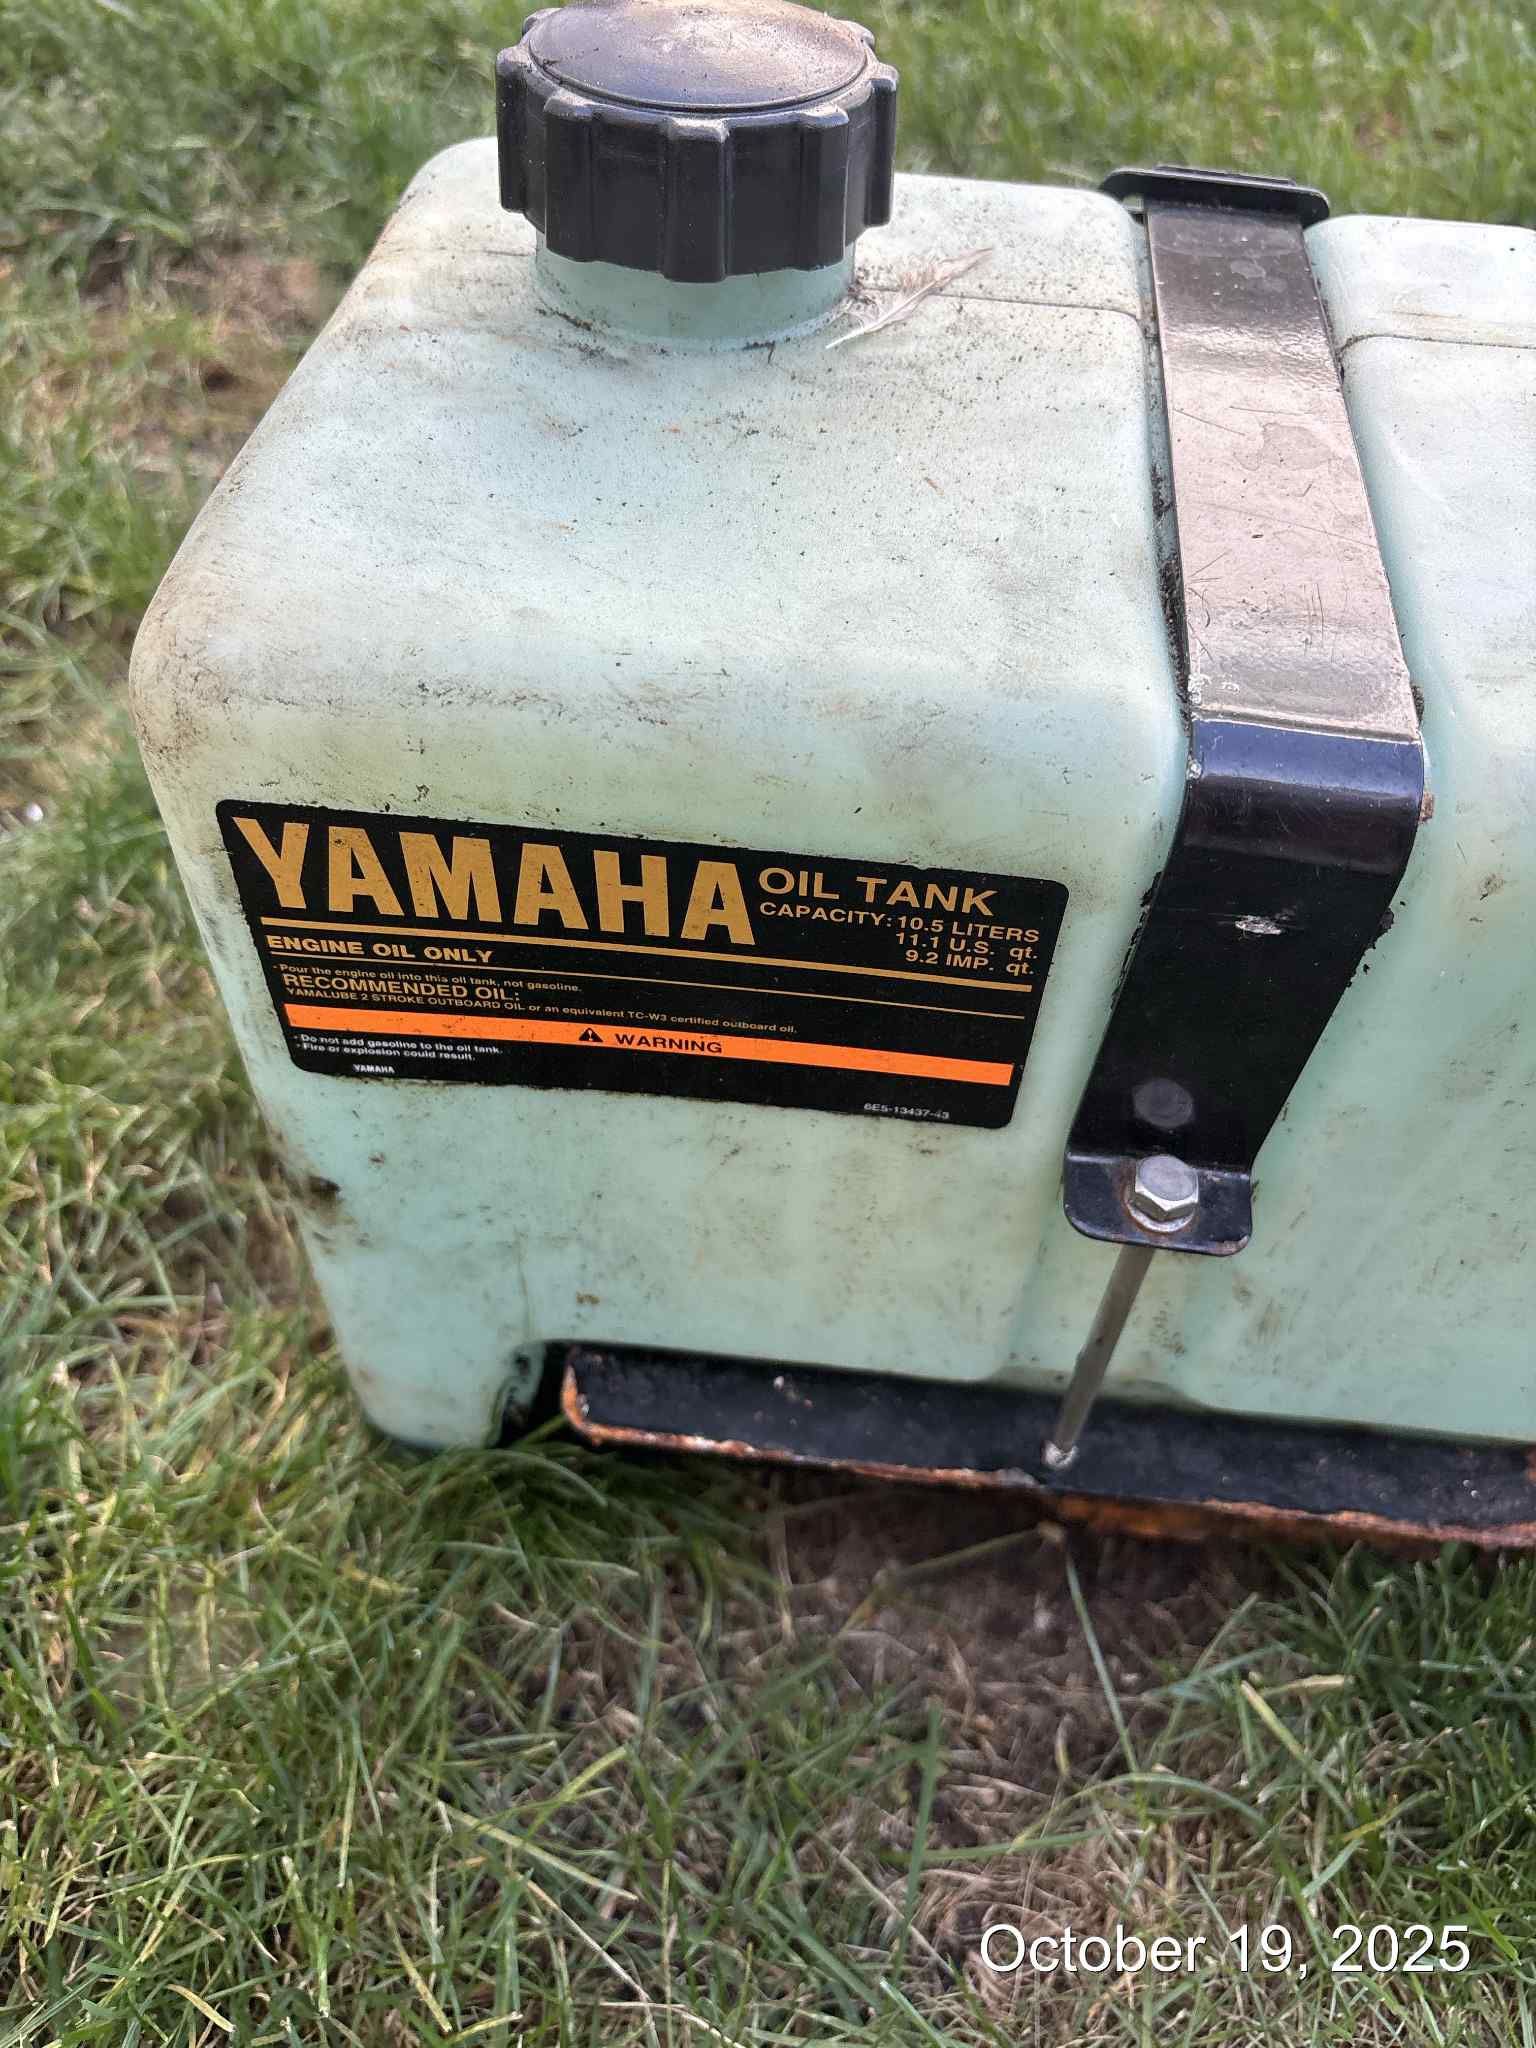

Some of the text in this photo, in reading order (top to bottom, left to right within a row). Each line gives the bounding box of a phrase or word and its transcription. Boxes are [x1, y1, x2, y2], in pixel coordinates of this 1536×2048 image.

[232, 816, 756, 946] YAMAHA
[758, 867, 998, 917] OIL TANK
[759, 902, 1040, 943] CAPACITY: 10.5 LITERS
[266, 935, 494, 963] ENGINE OIL ONLY
[896, 932, 1038, 960] 11.1 U.S. qt.
[280, 963, 308, 973] Pour
[311, 967, 332, 976] the
[335, 969, 377, 979] engine
[380, 971, 395, 979] oil
[398, 973, 421, 981] into
[425, 974, 449, 983] this
[452, 976, 466, 984] oil
[503, 979, 523, 988] not
[527, 981, 582, 992] gasoline.
[905, 951, 1035, 977] 9.2 IMP. qt.
[283, 973, 520, 1001] RECOMMENDED OIL:
[286, 987, 358, 1000] YAMALUBE
[371, 994, 425, 1004] STROKE
[427, 997, 501, 1009] OUTBOARD
[503, 1002, 525, 1011] OIL
[562, 1006, 625, 1018] equivalent
[627, 1011, 668, 1022] TC-W3
[670, 1015, 720, 1026] certified
[722, 1020, 777, 1033] outboard
[780, 1025, 798, 1034] oil.
[300, 1034, 318, 1042] Do
[320, 1037, 339, 1045] not
[342, 1038, 364, 1046] add
[367, 1040, 417, 1050] gasoline
[420, 1042, 432, 1050] to
[435, 1043, 454, 1051] the
[474, 1045, 503, 1054] tank.
[303, 1043, 326, 1051] Fire
[343, 1046, 400, 1056] explosion
[403, 1050, 436, 1058] could
[439, 1052, 476, 1061] result.
[615, 1033, 723, 1054] WARNING
[353, 1063, 395, 1073] YAMAHA
